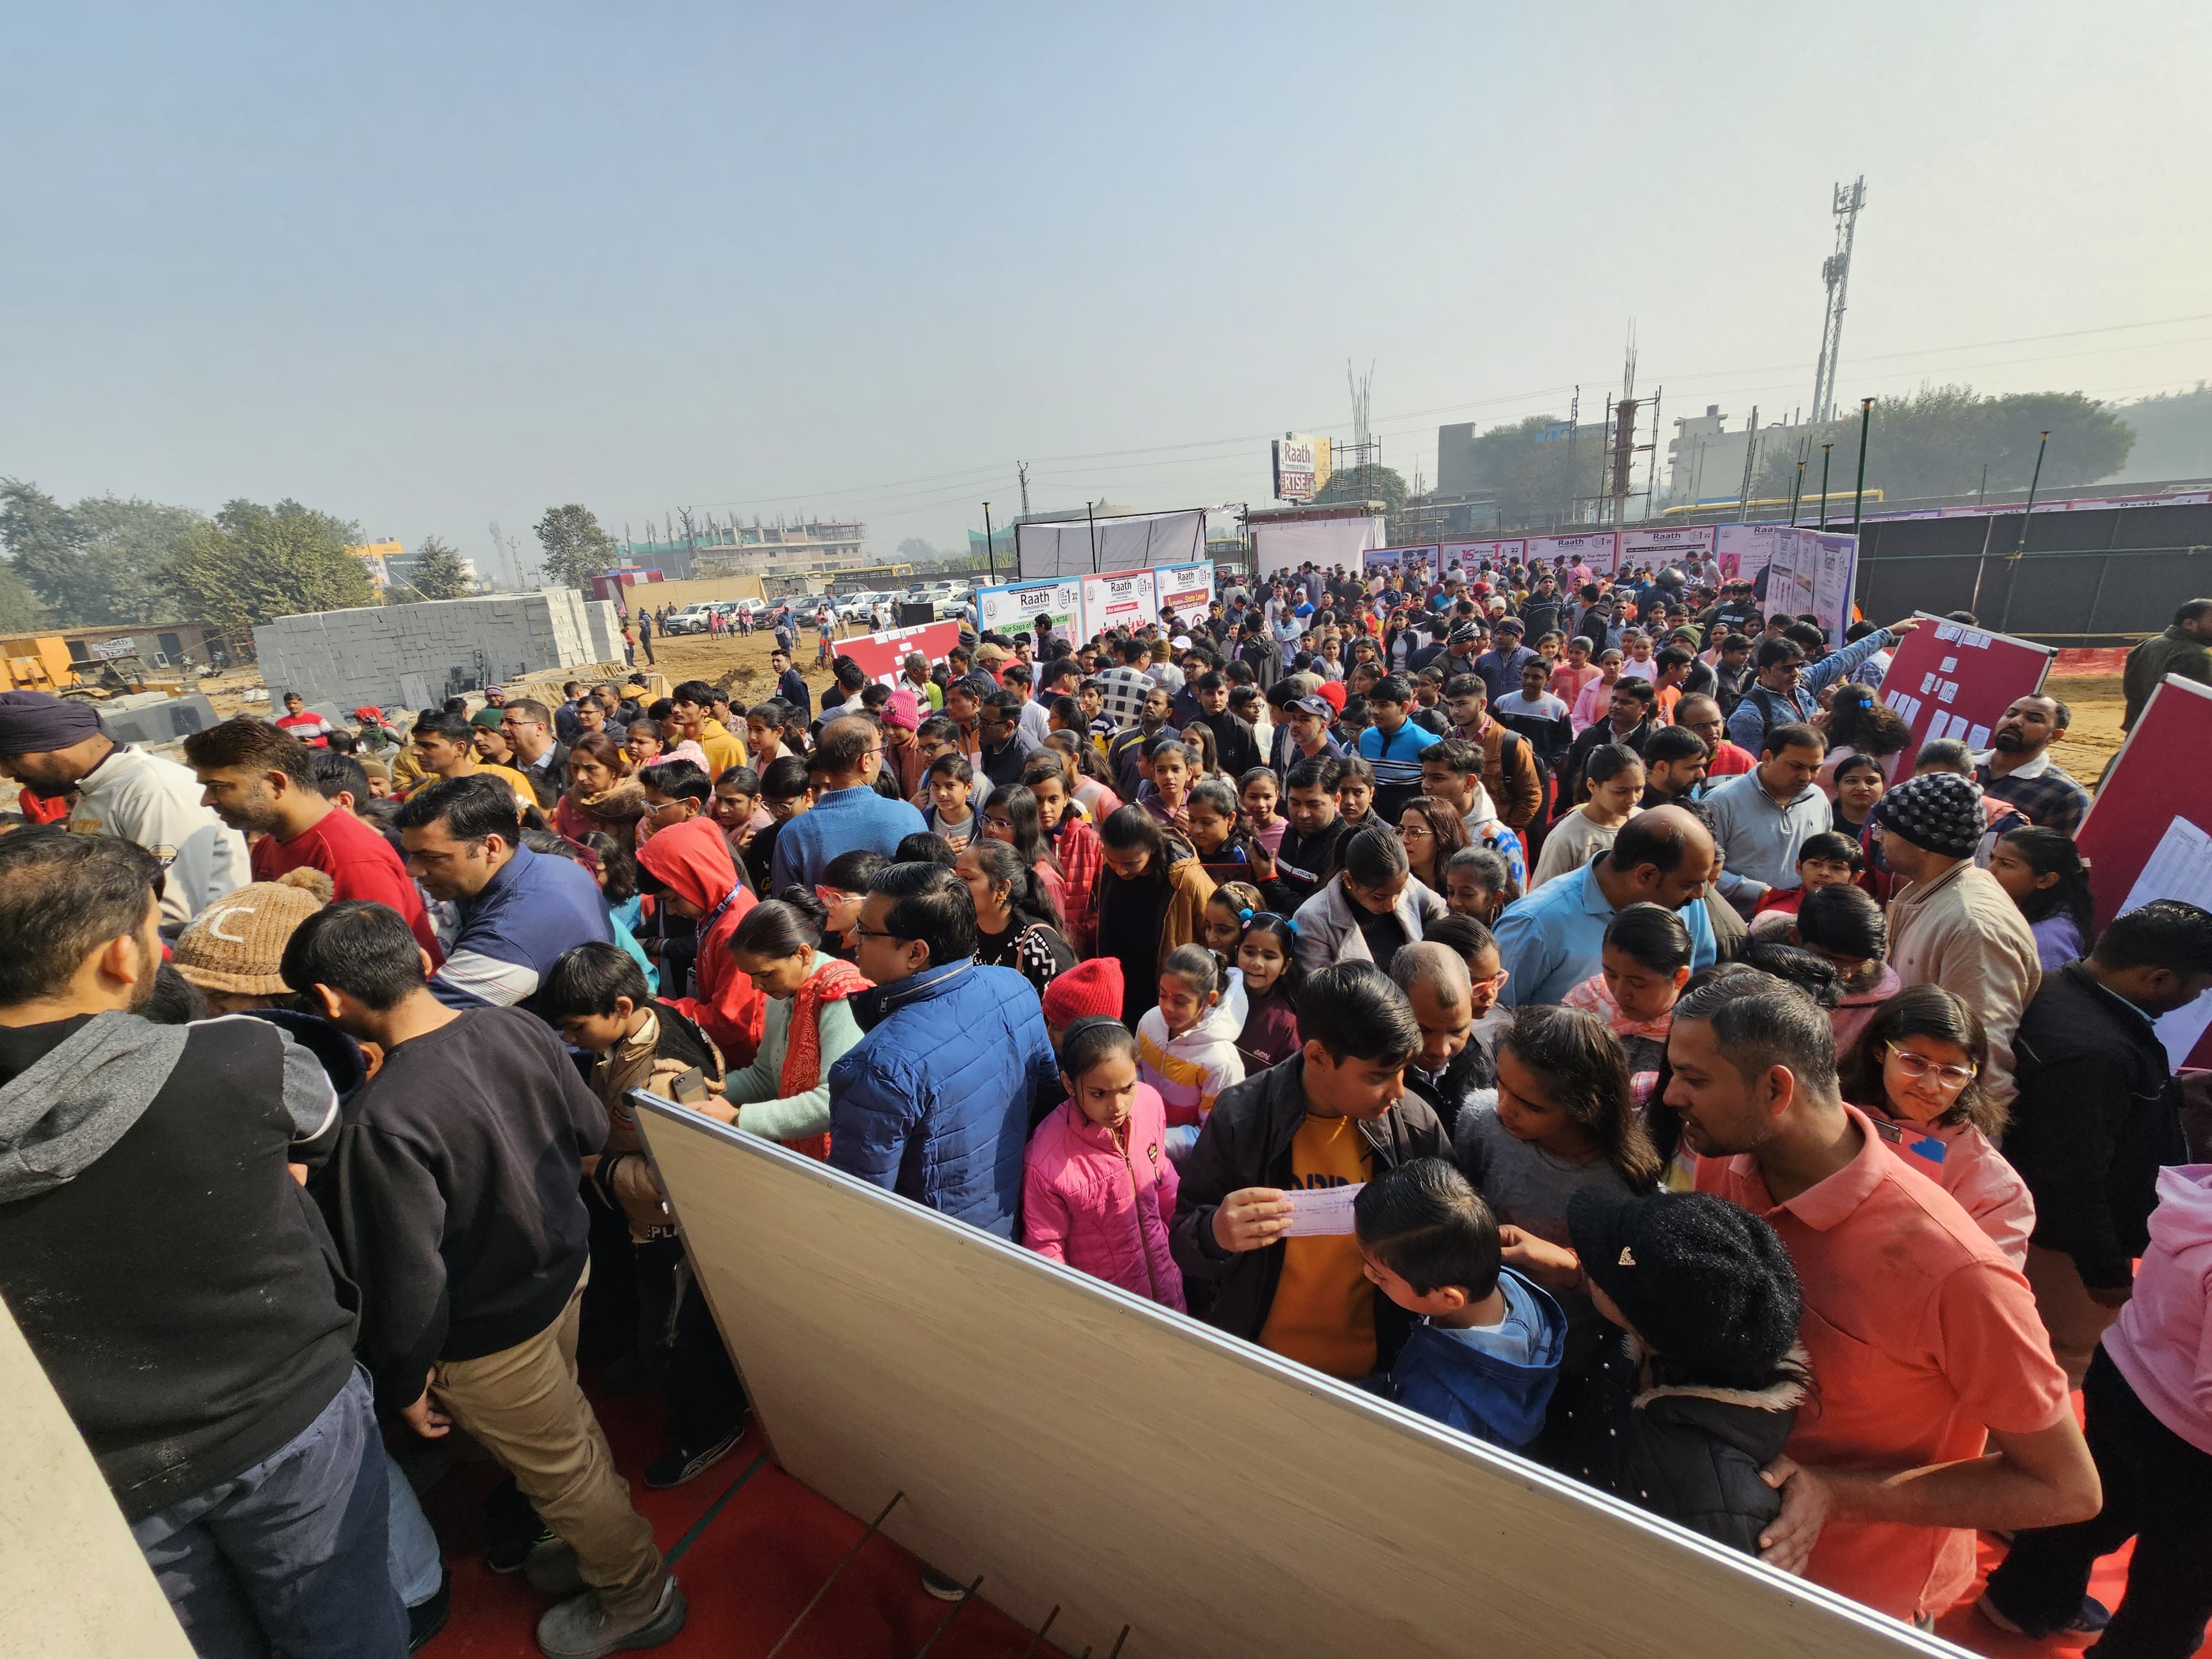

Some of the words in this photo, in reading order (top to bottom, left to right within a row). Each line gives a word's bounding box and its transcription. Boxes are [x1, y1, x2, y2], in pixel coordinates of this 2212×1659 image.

[1285, 442, 1310, 463] Raath
[1285, 473, 1306, 490] RTSE
[1462, 549, 1475, 561] 15
[1492, 543, 1501, 560] 1
[1178, 571, 1194, 582] Raath
[1111, 580, 1132, 592] Raath
[1021, 591, 1050, 606] Raath
[1195, 592, 1206, 601] Level
[1002, 624, 1012, 633] Our
[1013, 623, 1025, 632] Saga
